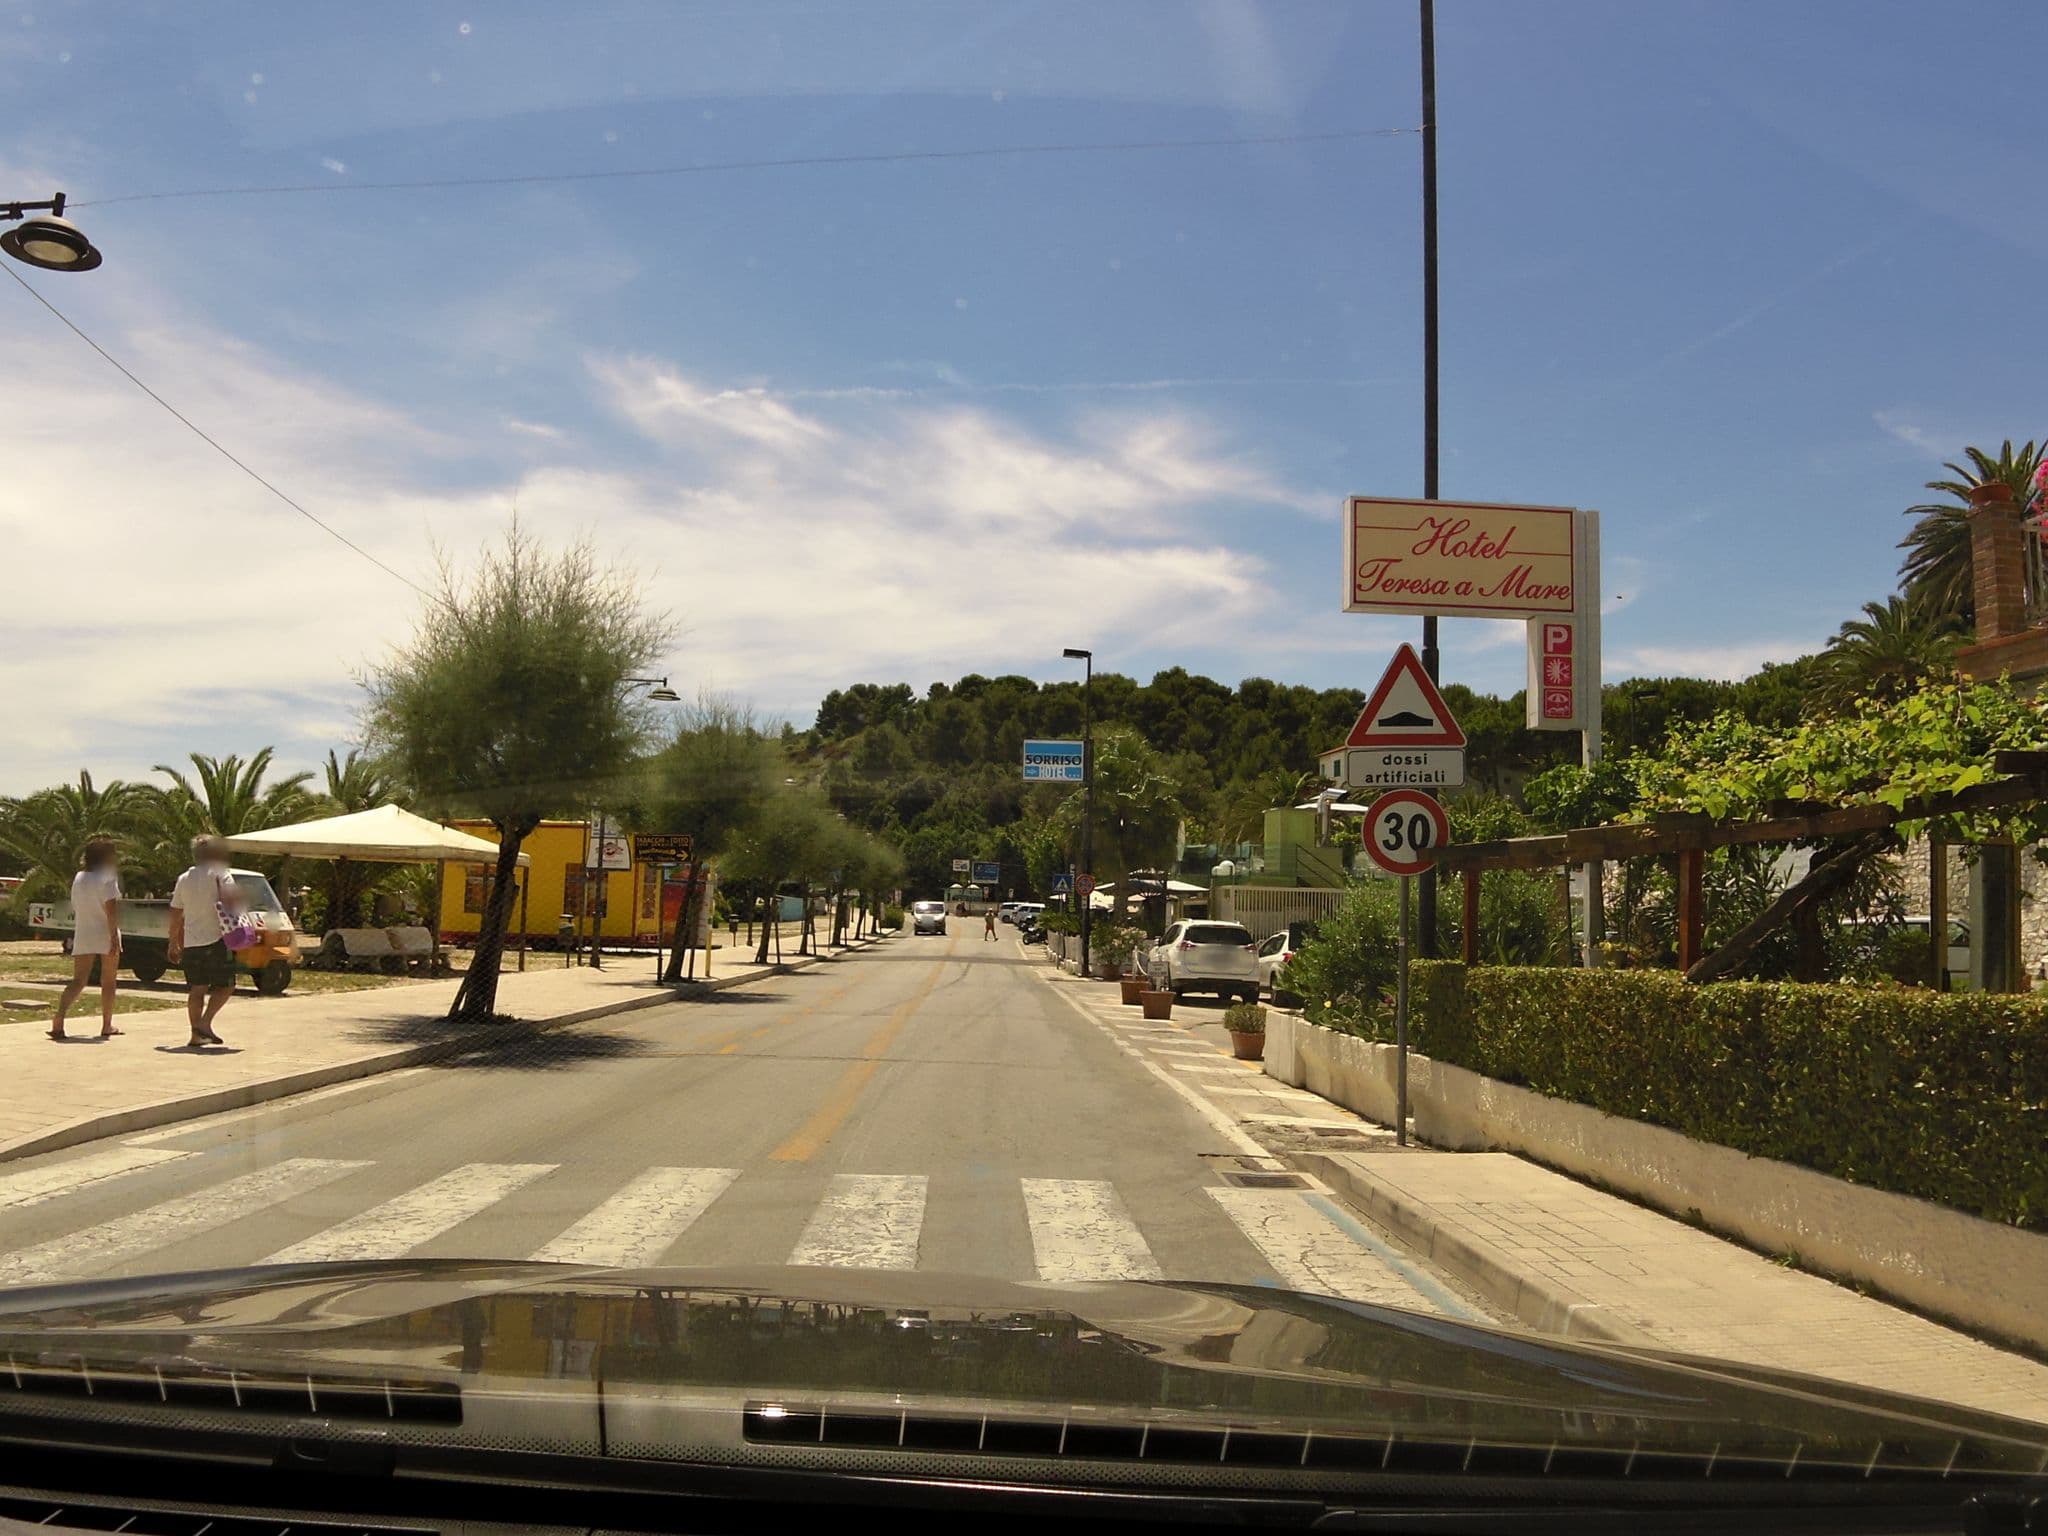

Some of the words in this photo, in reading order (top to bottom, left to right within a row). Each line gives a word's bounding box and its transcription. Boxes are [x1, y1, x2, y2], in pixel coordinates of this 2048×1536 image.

[1411, 515, 1517, 560] Hotel
[1356, 557, 1451, 596] Teresa
[1454, 579, 1474, 597] a
[1478, 564, 1572, 601] Mare
[1546, 625, 1569, 653] P
[1025, 754, 1082, 766] SORRISO
[1382, 753, 1428, 766] dossi
[1040, 766, 1068, 779] HOTEL
[1365, 770, 1445, 784] artificiali
[1382, 812, 1431, 851] 30
